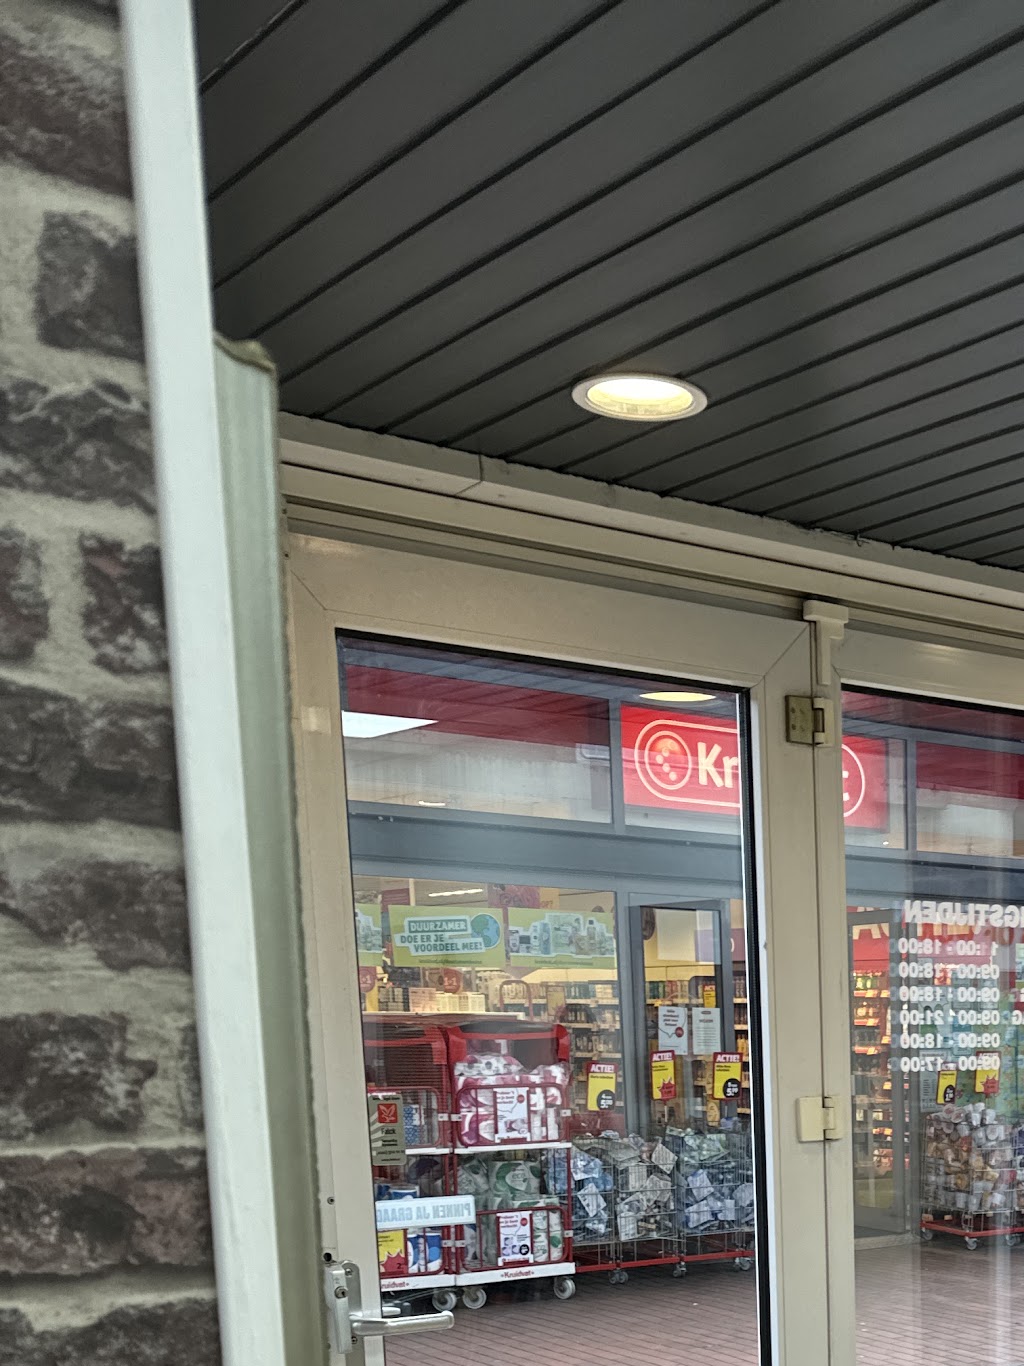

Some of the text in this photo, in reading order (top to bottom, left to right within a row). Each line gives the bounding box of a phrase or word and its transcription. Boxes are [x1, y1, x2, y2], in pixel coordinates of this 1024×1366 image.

[410, 921, 467, 932] DUURZAMER
[400, 934, 445, 944] DOE ER JE
[414, 943, 460, 952] VOORDEEL
[381, 1281, 406, 1289] ruidvat
